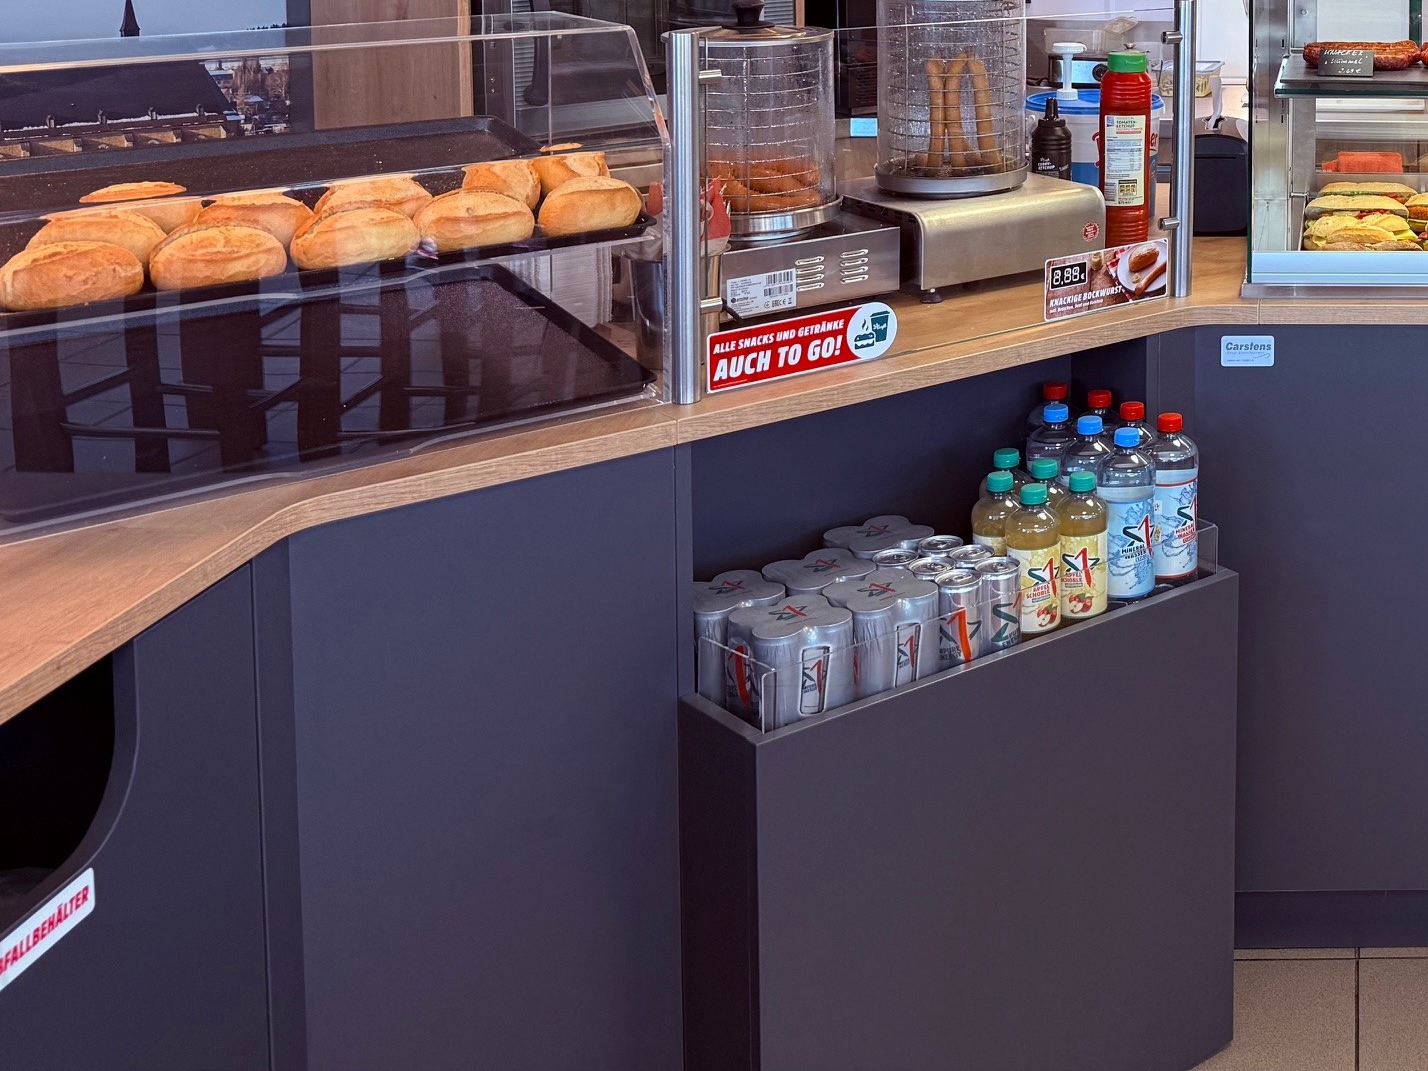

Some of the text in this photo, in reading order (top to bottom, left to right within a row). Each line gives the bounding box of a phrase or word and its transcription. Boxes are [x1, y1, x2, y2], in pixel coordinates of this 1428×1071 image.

[1049, 285, 1123, 308] KNACKIGE BOCKWURST
[713, 319, 845, 355] ALLE SNACKS UND GETRÄNKE
[1225, 341, 1272, 351] Carstens
[713, 334, 843, 382] AUCH TO GO!
